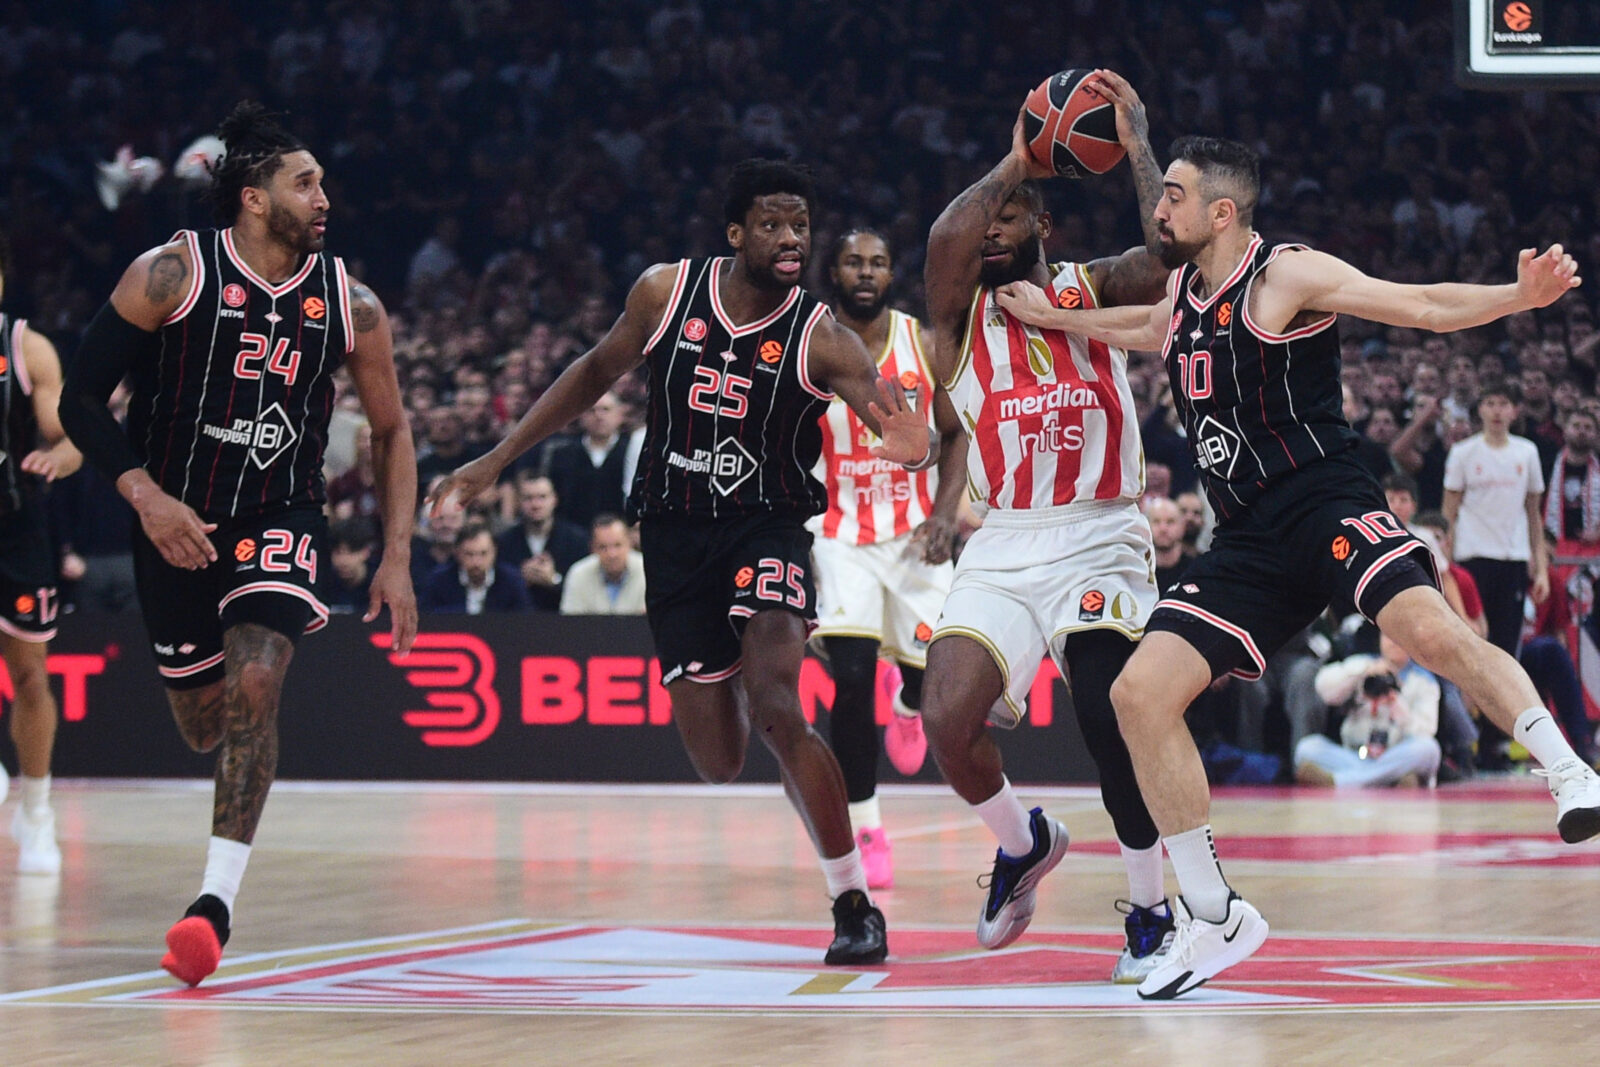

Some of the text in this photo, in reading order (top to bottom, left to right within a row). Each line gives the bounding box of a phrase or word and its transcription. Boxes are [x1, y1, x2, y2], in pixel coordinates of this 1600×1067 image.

[234, 332, 302, 386] 24
[1178, 350, 1211, 400] 10
[688, 365, 753, 419] 25
[1000, 383, 1099, 419] meridian
[252, 422, 284, 449] IBI
[1201, 433, 1231, 465] IBI
[713, 453, 743, 476] IBI
[1340, 511, 1409, 545] 10
[260, 529, 317, 584] 24
[756, 558, 806, 609] 25
